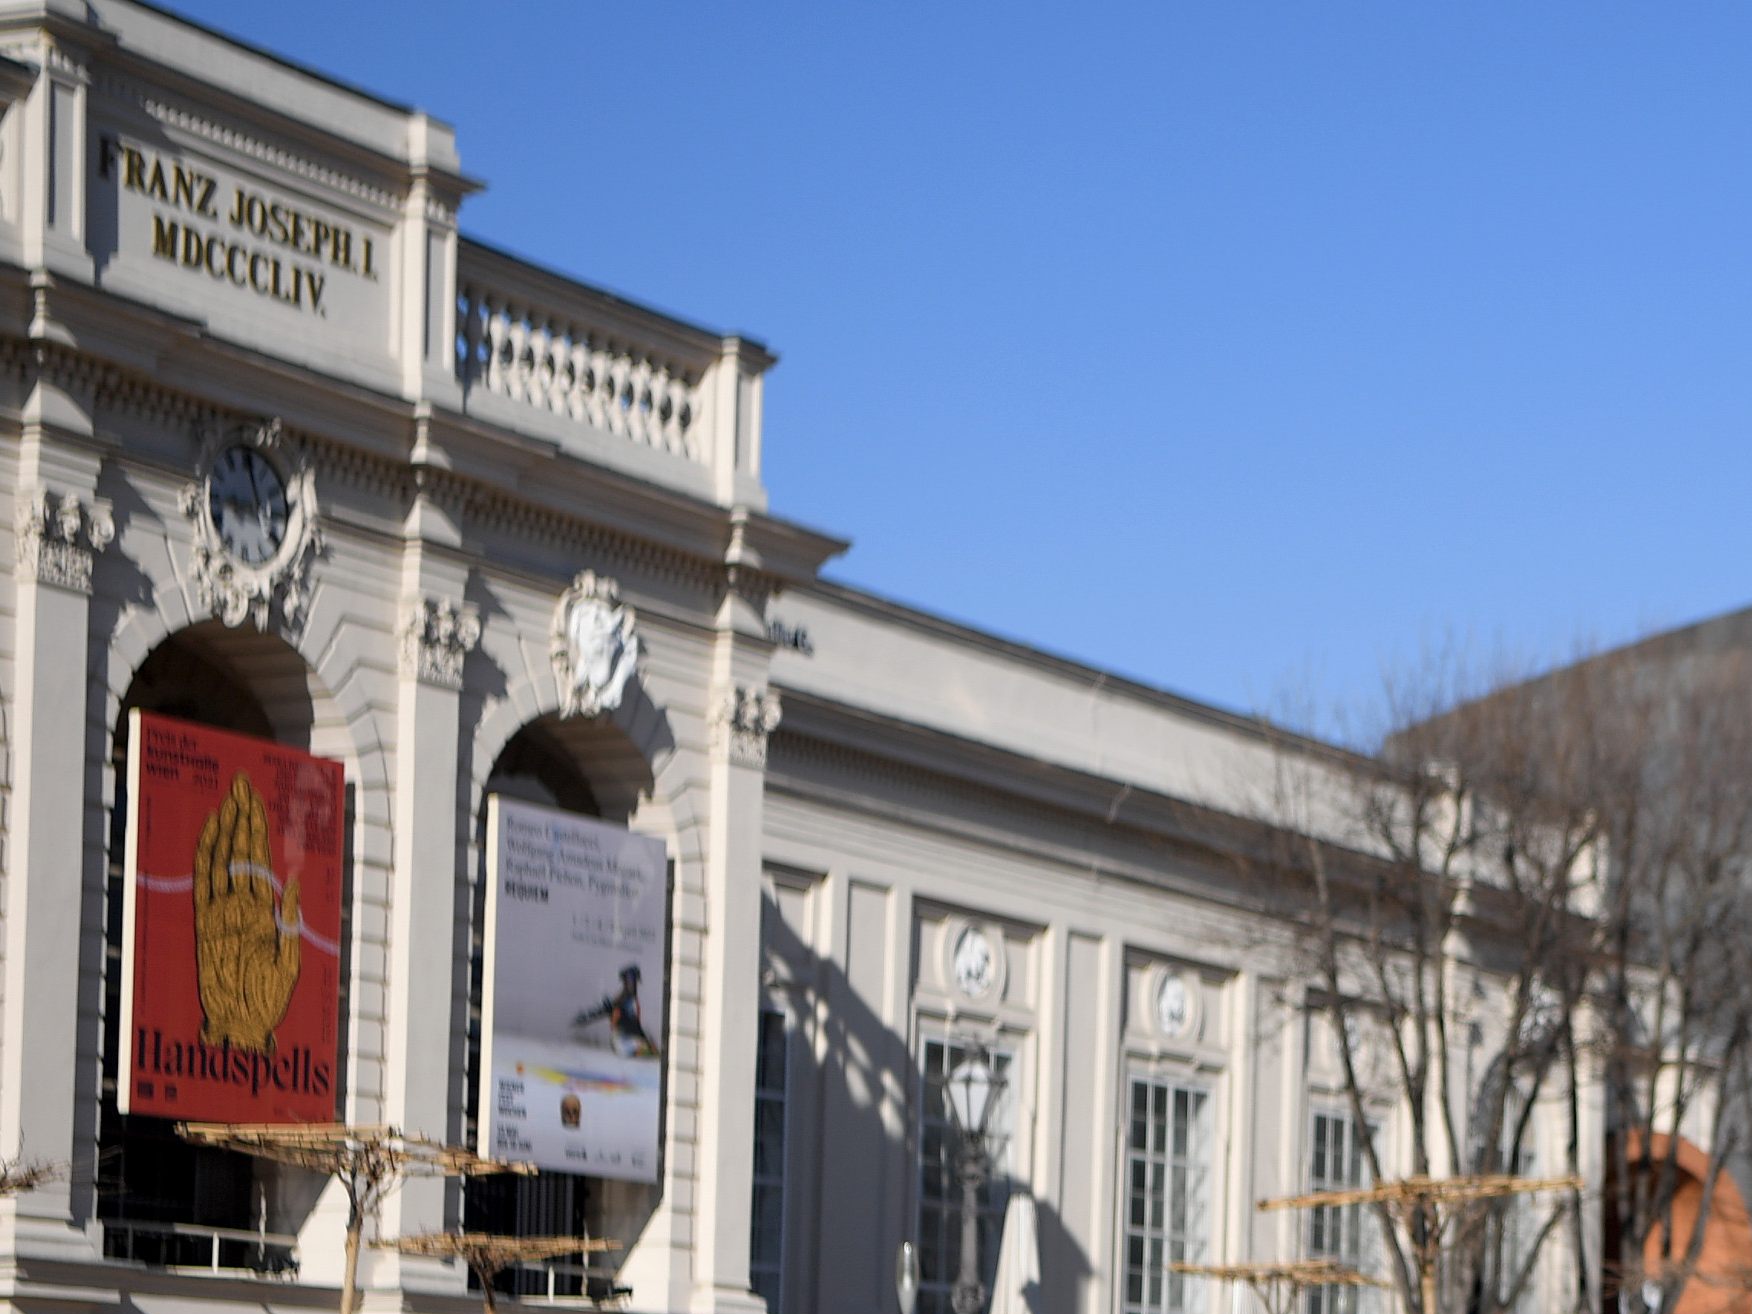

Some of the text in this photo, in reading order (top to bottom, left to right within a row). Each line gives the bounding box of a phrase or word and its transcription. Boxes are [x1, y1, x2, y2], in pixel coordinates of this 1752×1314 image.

[99, 135, 217, 219] FRANZ
[153, 212, 327, 319] MDCCCLIV.
[138, 1028, 330, 1097] Handspells
